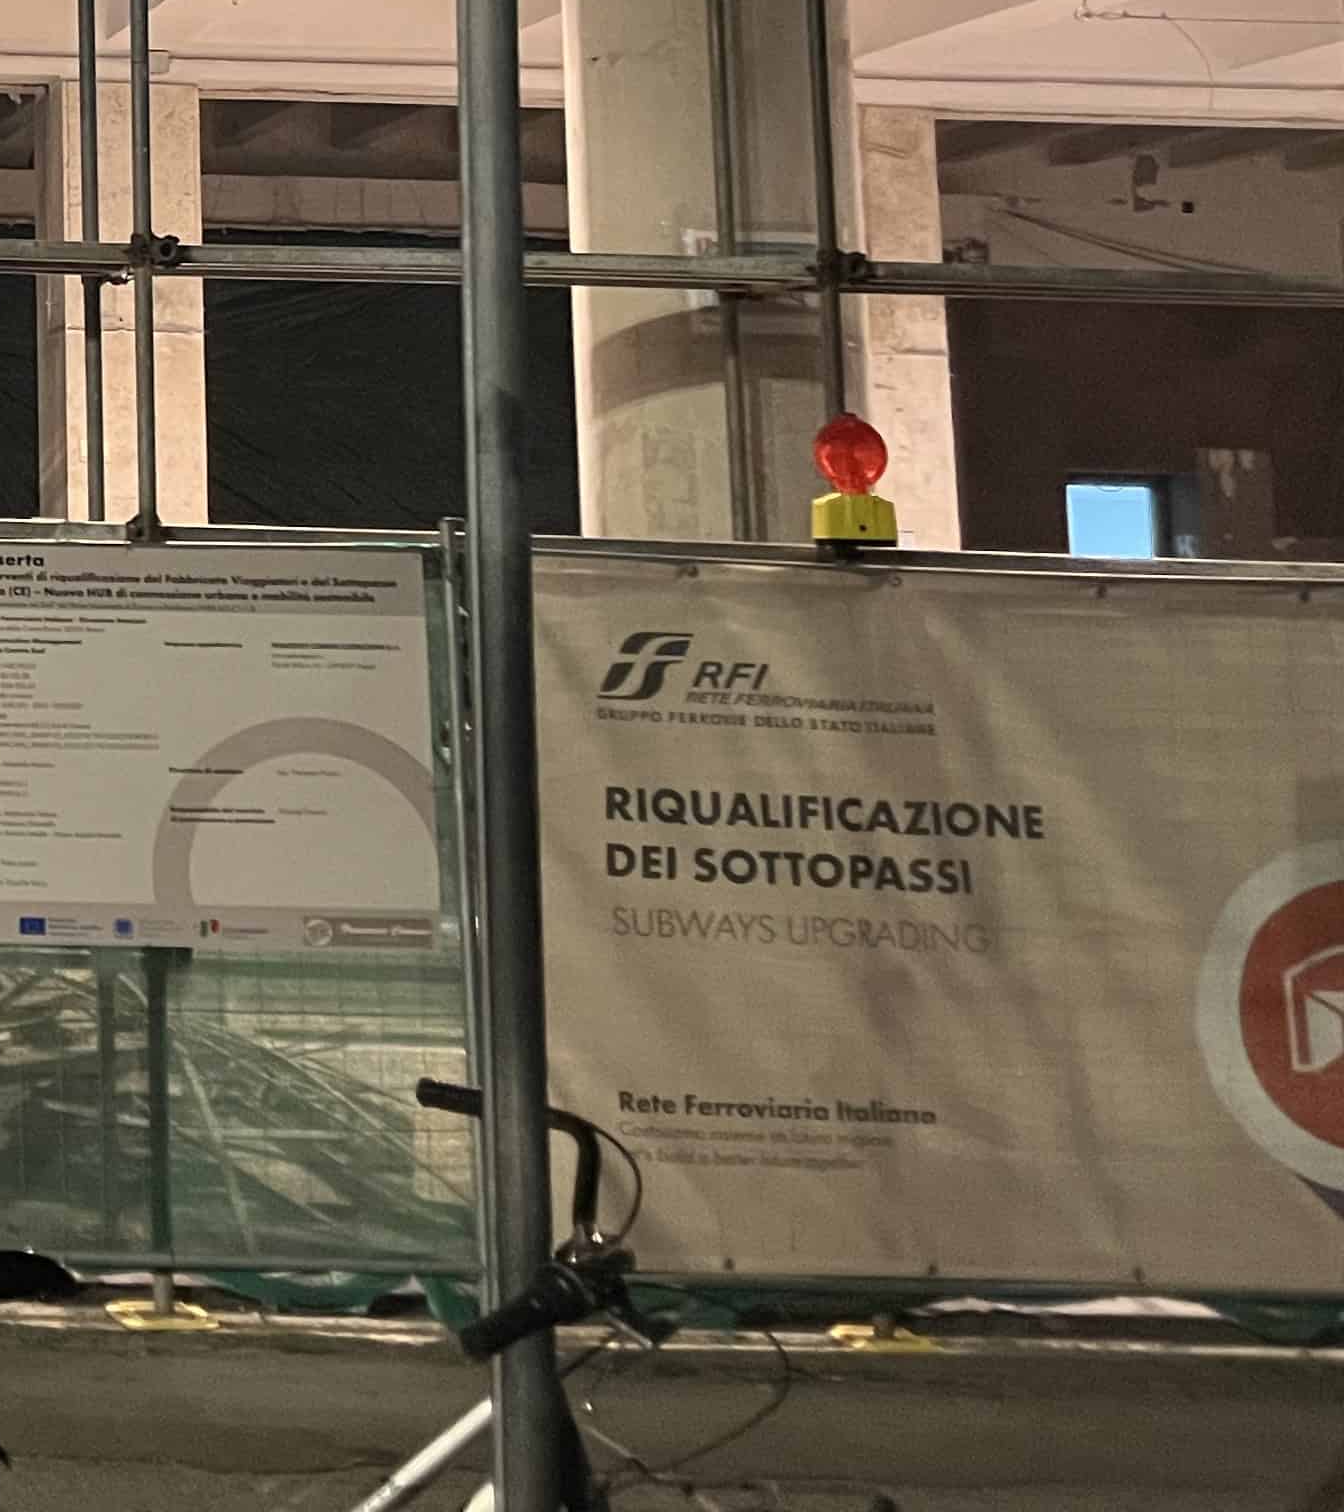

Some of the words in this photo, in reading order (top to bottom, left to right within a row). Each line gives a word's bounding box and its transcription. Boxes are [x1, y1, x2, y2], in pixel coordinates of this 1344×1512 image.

[692, 661, 769, 690] RFI
[685, 691, 731, 704] RETE
[596, 708, 662, 723] GRUPPO
[752, 715, 802, 728] DELLO
[605, 786, 1045, 840] RIQUALIFICAZIONE
[606, 842, 677, 880] DEI
[693, 846, 973, 895] SOTTOPASSI
[611, 905, 776, 944] SUBWAYS
[788, 913, 993, 955] UPGRADING
[618, 1090, 677, 1115] Rete
[684, 1093, 830, 1121] Ferroviaria
[836, 1099, 938, 1125] Italiana
